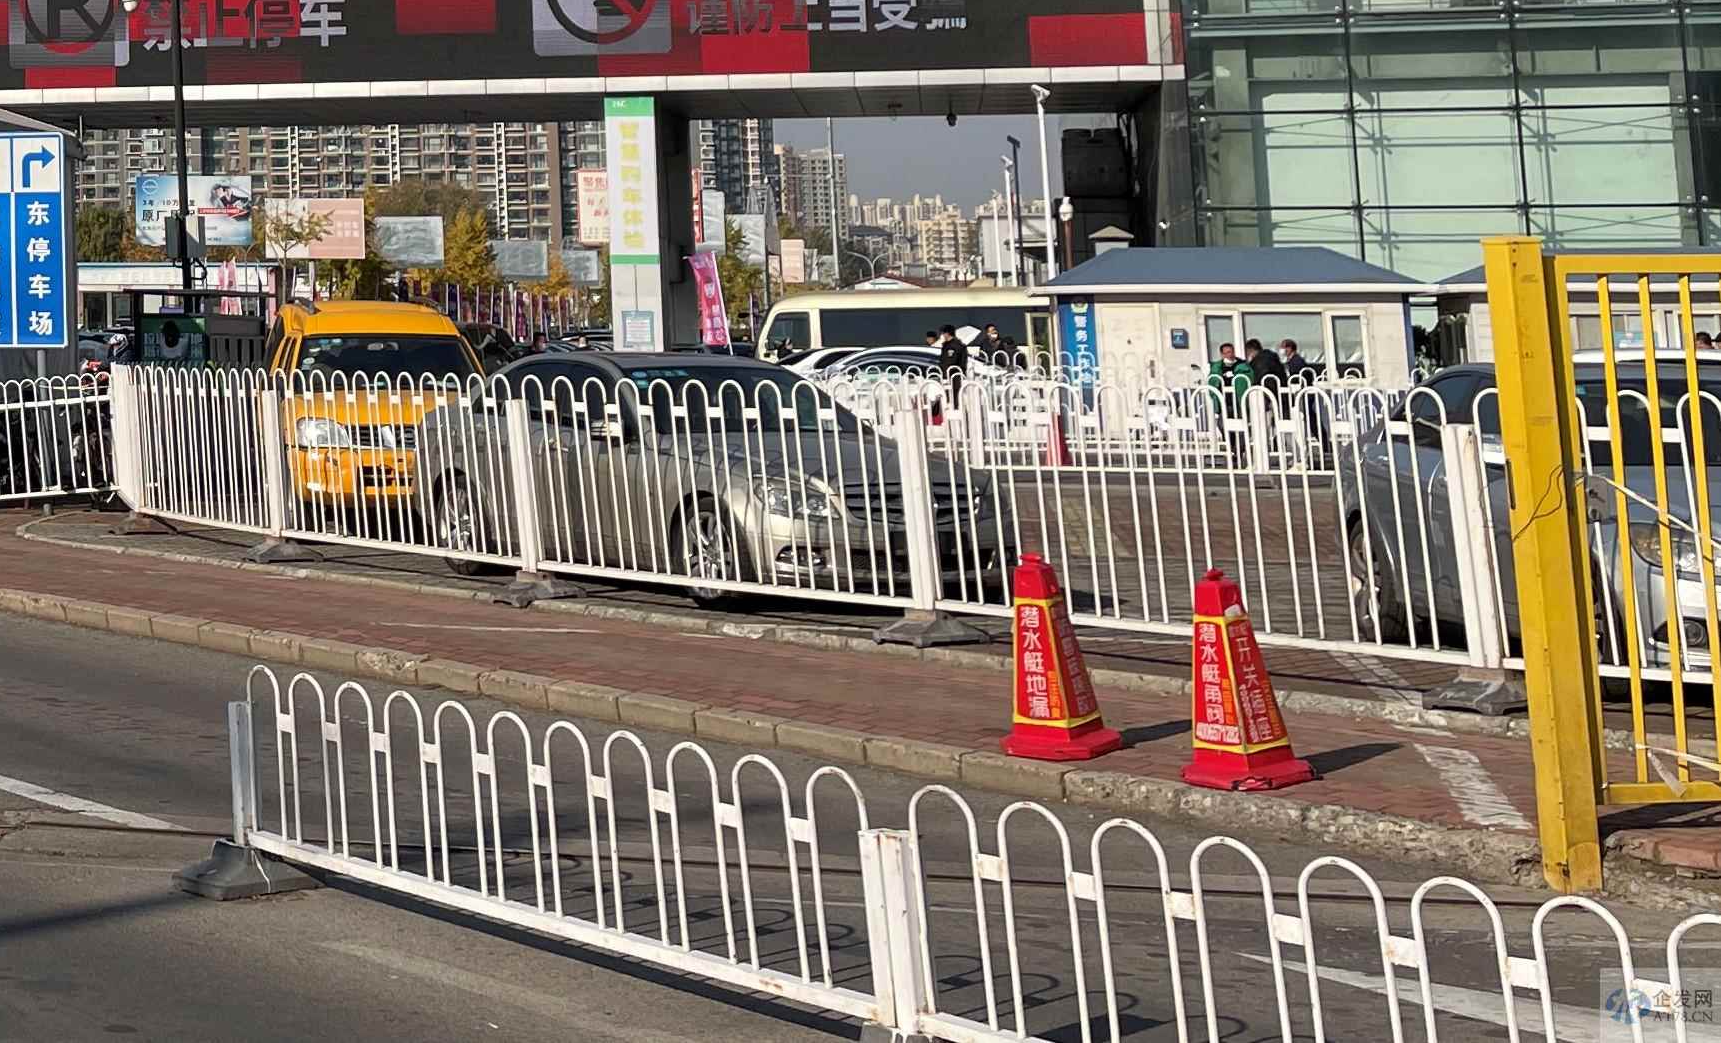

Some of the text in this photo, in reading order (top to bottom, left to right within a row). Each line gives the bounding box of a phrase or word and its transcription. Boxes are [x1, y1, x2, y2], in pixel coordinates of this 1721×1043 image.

[26, 201, 53, 335] 东停车场
[1020, 605, 1050, 718] 潜水艇地漏
